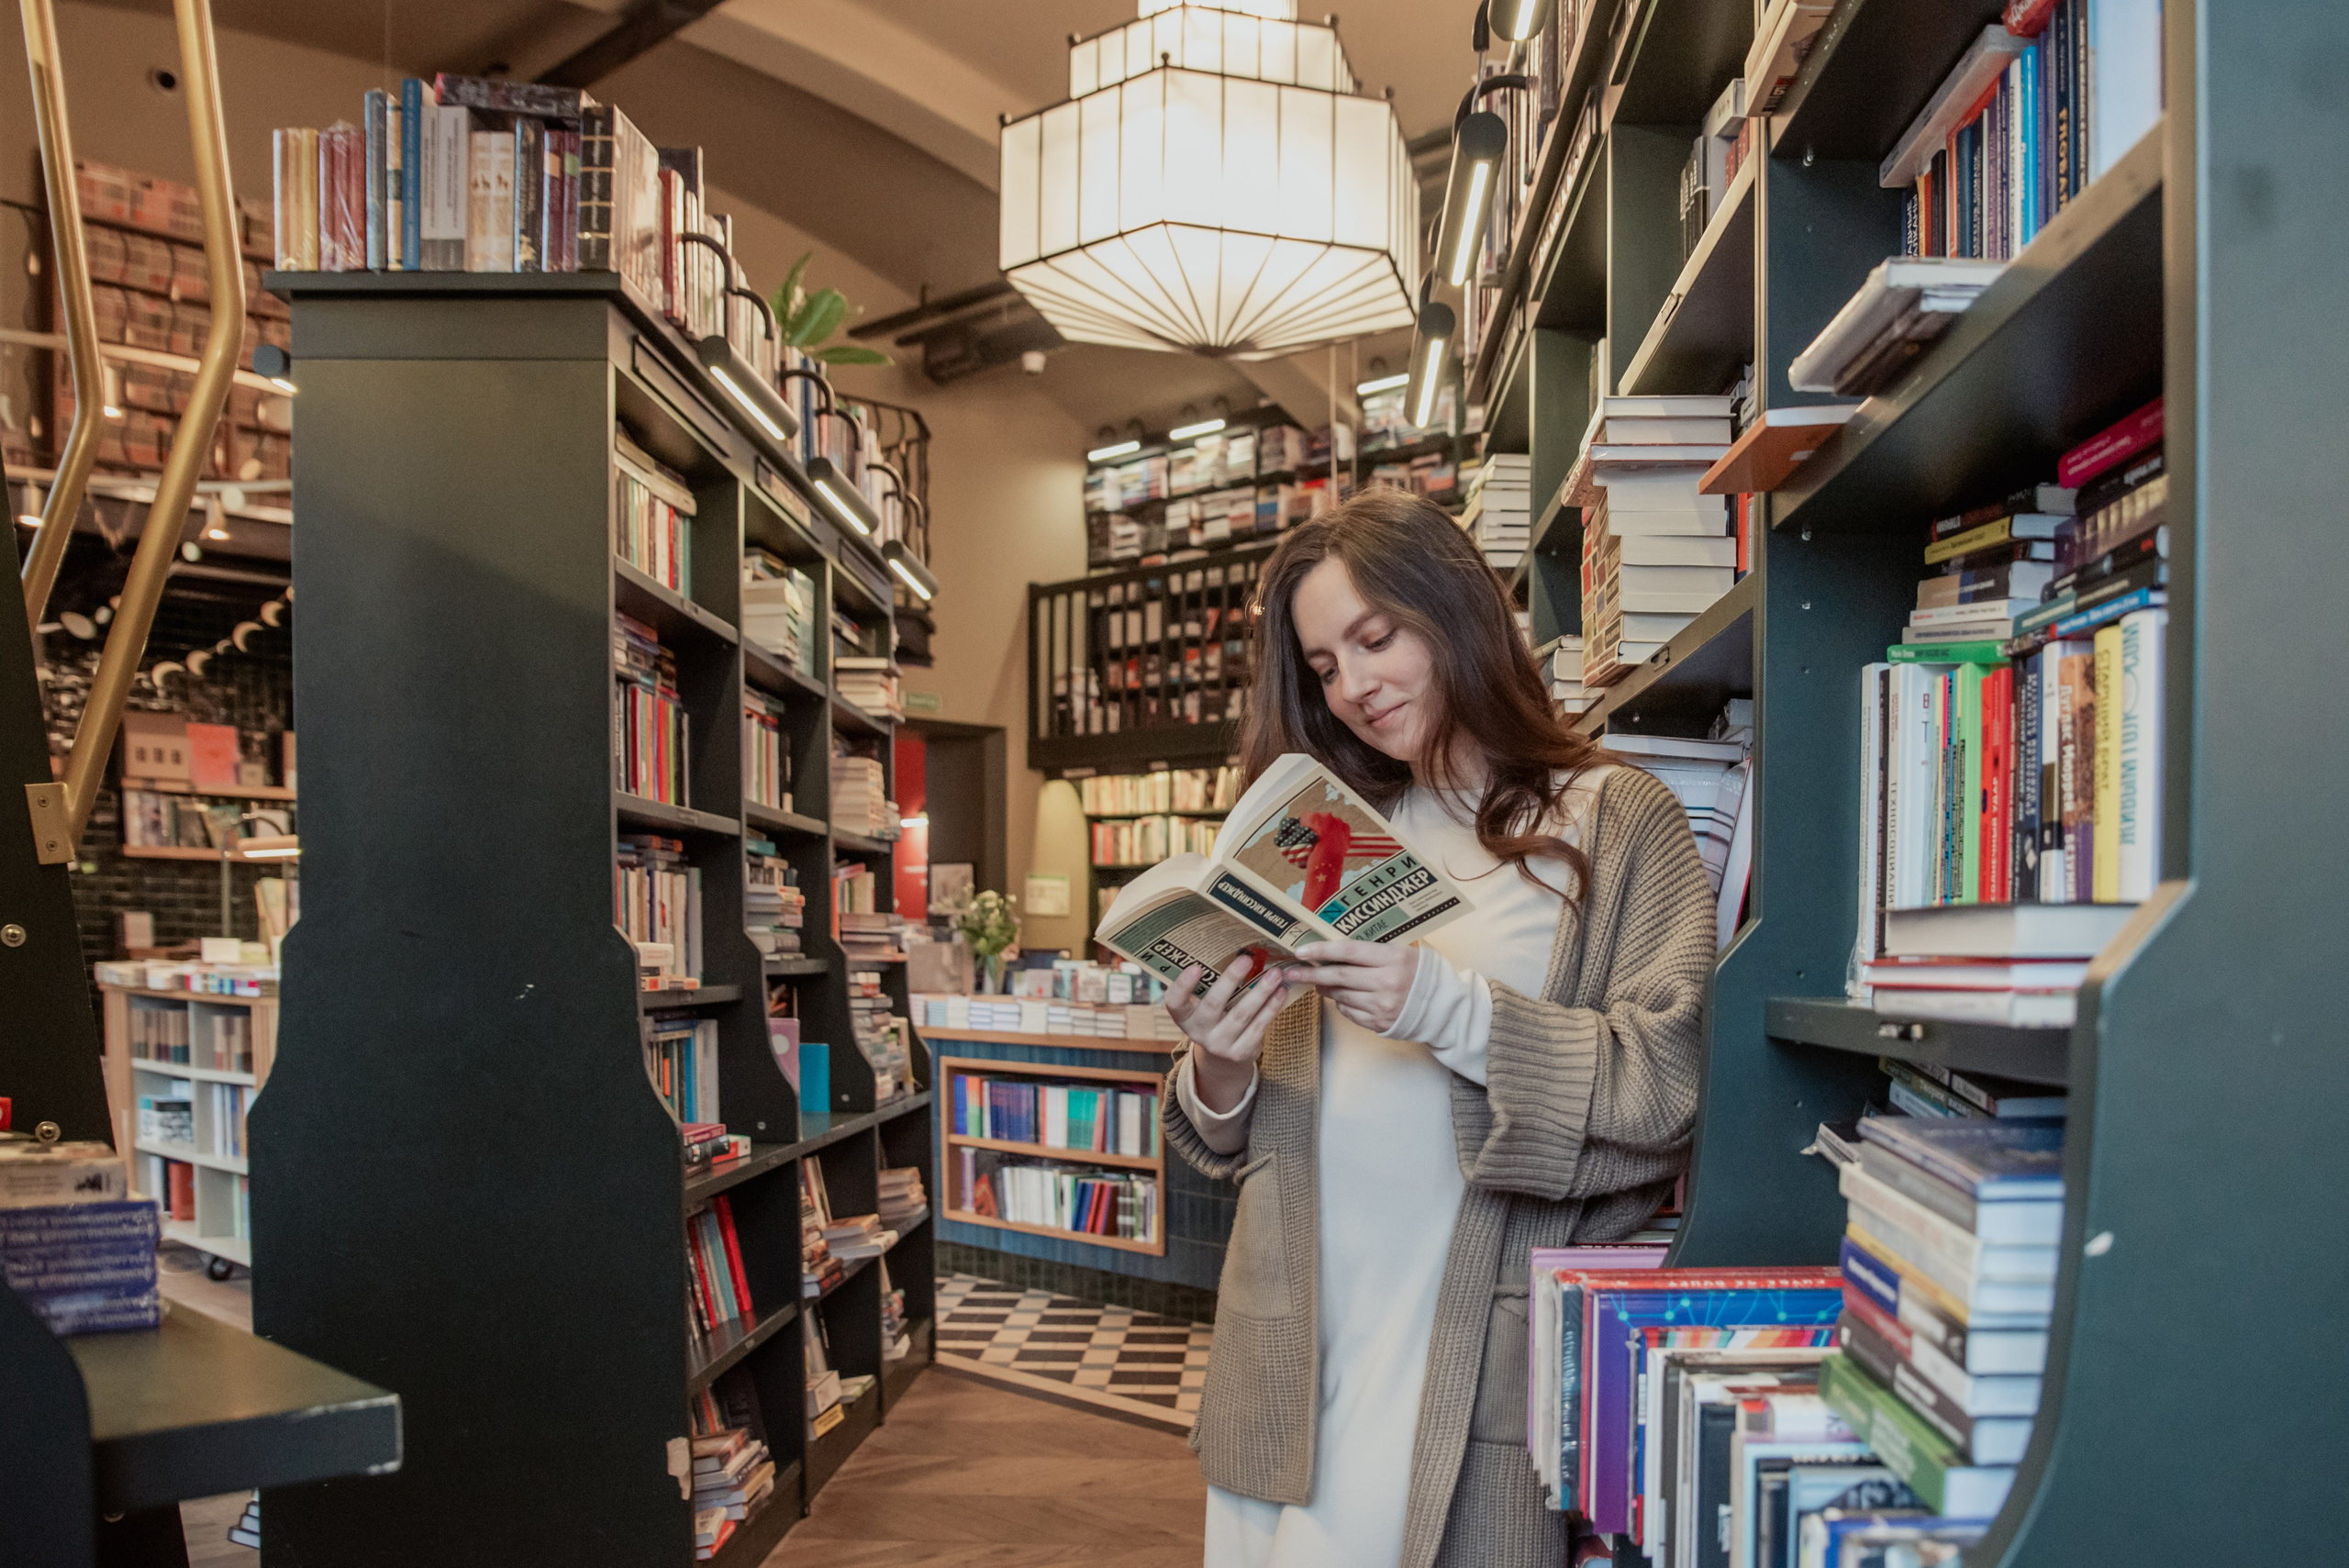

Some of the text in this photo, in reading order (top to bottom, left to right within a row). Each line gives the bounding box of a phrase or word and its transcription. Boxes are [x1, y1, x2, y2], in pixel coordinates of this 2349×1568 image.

[2060, 745, 2076, 812] Мюррей
[1218, 881, 1288, 929] ГЕНРИ КИССИНДЖЕР
[1335, 870, 1430, 934] КИССИНДЖЕР
[1341, 856, 1417, 906] ГЕНРИ
[1363, 919, 1389, 938] КИТАЕ
[1153, 942, 1221, 987] ССИДЖЕР
